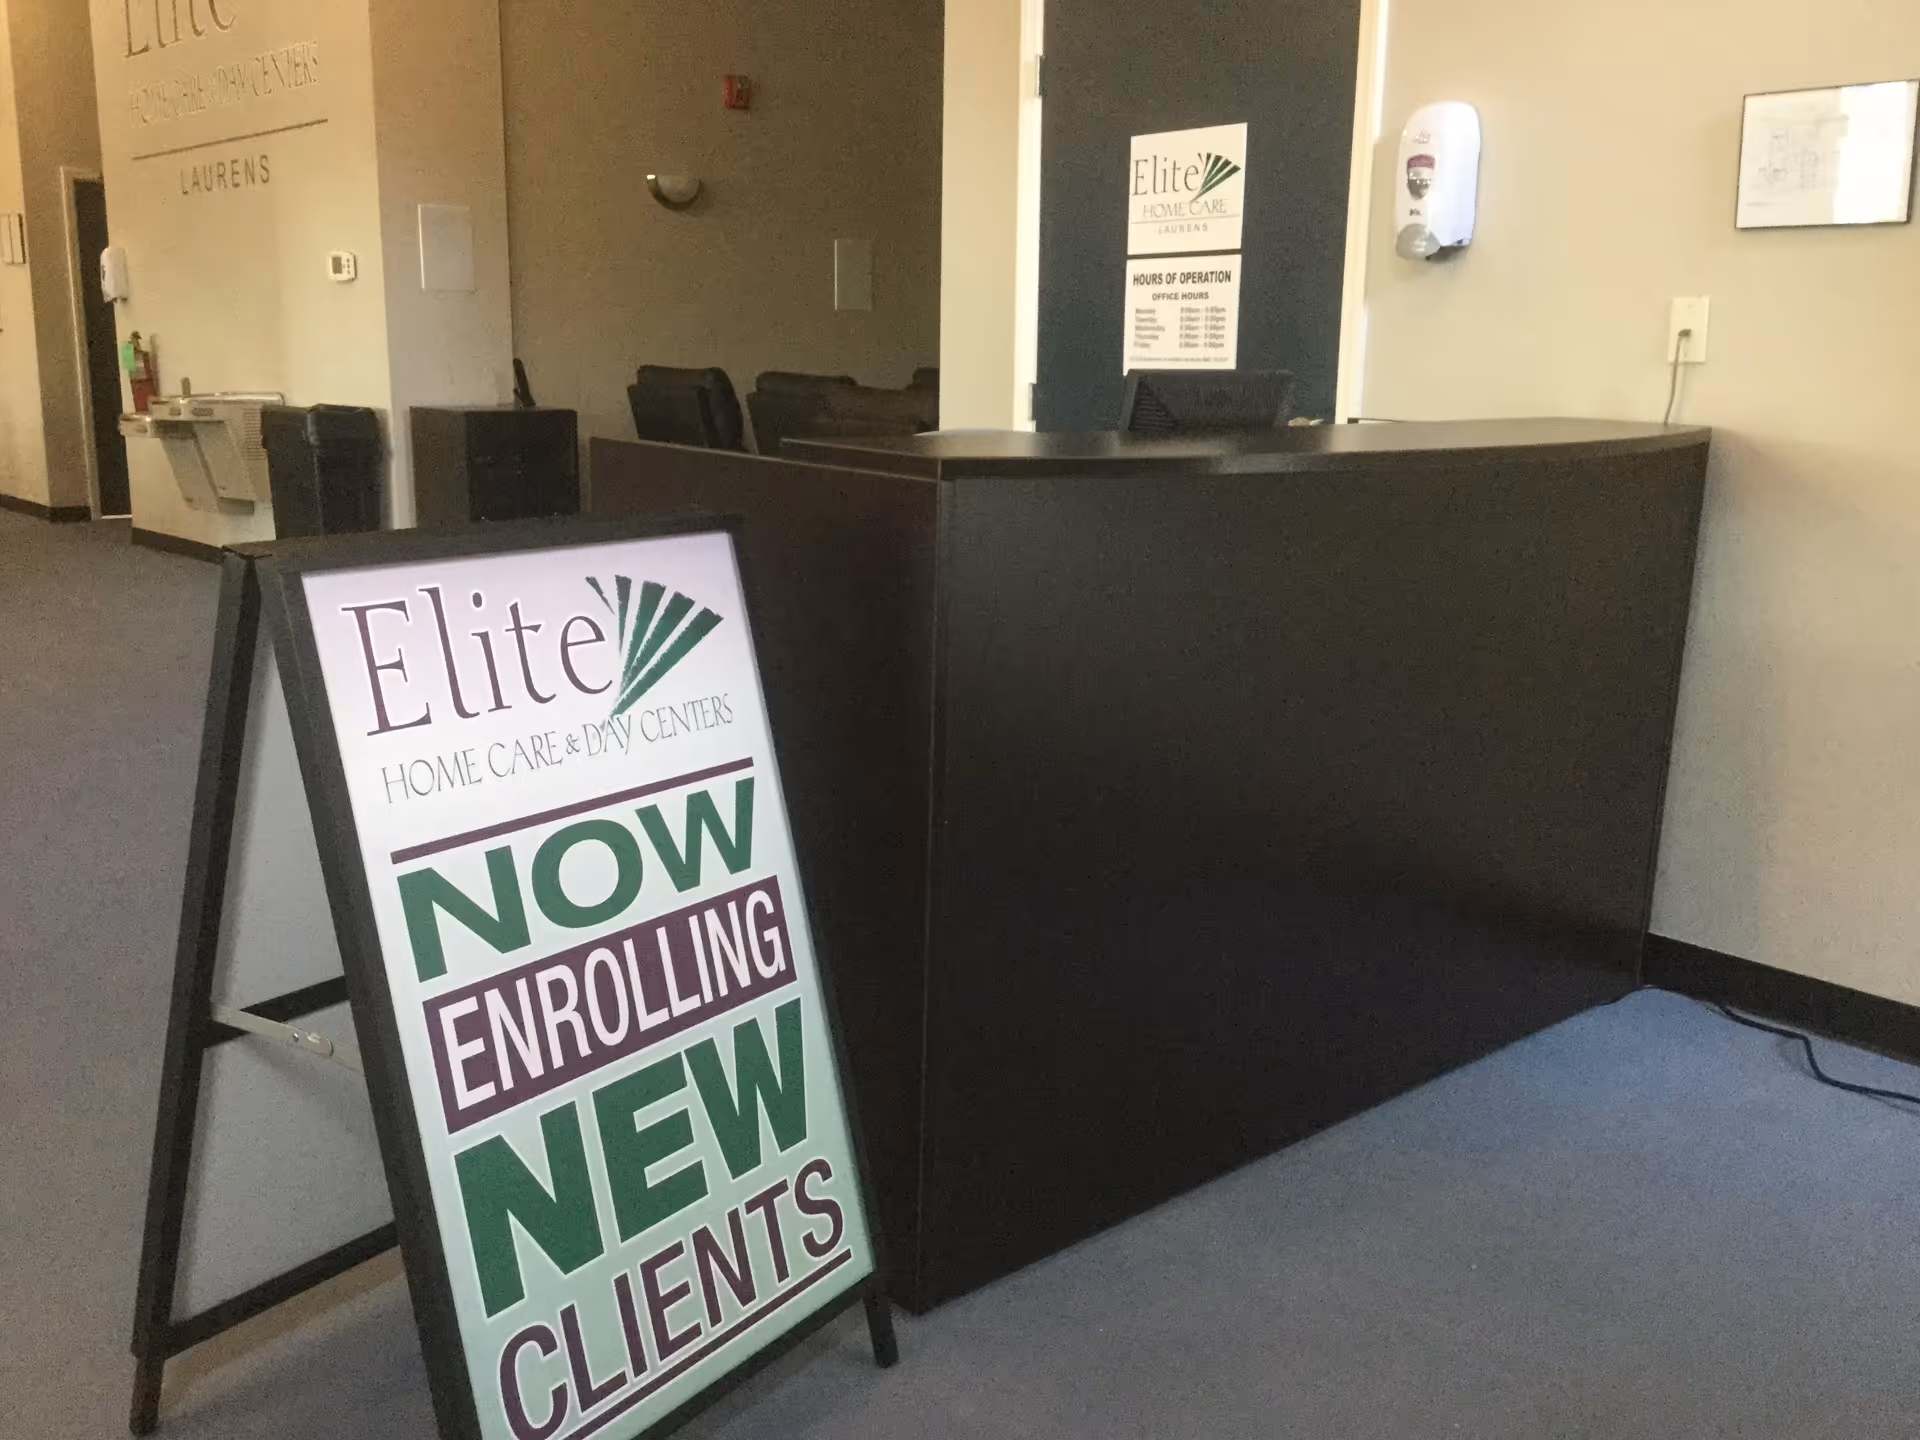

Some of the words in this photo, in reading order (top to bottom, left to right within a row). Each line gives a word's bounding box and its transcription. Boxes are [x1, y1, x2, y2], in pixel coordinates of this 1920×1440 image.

[180, 154, 271, 195] LAURENS
[1132, 154, 1200, 196] Elite
[1142, 202, 1186, 219] HOME
[1188, 199, 1229, 216] CARE
[1158, 222, 1209, 235] LAURENS
[1133, 272, 1163, 286] HOURS
[1165, 271, 1178, 285] OF
[1179, 269, 1232, 284] OPERATION
[1151, 292, 1179, 301] OFFICE
[1181, 291, 1210, 301] HOURS
[341, 586, 614, 737] Elite
[381, 747, 483, 804] HOME
[487, 730, 564, 778] CARE
[565, 733, 581, 755] &
[582, 714, 632, 757] DAY
[640, 693, 734, 743] CENTERS
[396, 776, 755, 984] NOW
[438, 889, 787, 1111] ENROLLING
[453, 997, 807, 1319] NEW
[498, 1157, 844, 1440] CLIENTS
